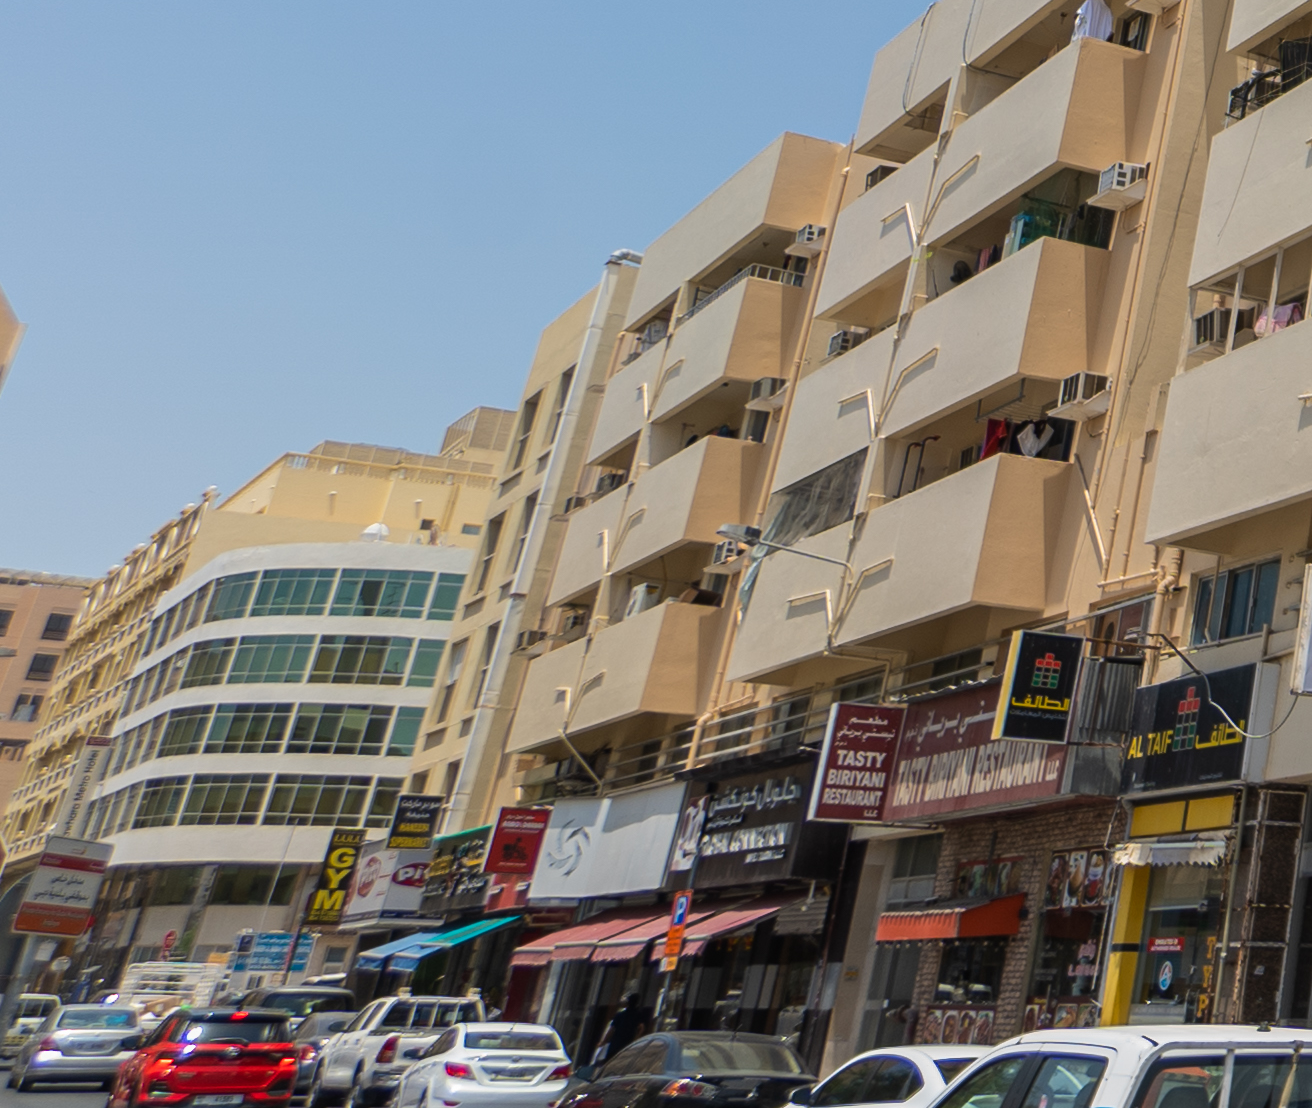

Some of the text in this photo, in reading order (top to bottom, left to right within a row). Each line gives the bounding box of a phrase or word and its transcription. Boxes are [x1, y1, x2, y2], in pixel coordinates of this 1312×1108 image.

[837, 749, 887, 768] TASTY
[1127, 730, 1174, 760] AL TAIF
[826, 769, 886, 788] BIRIYANI
[892, 755, 931, 807] TASTY
[924, 746, 977, 802] BIRIYANI
[970, 741, 1049, 794] RESTAURANT
[822, 787, 883, 807] RESTAURANT
[313, 847, 357, 910] GYM
[674, 897, 688, 924] P
